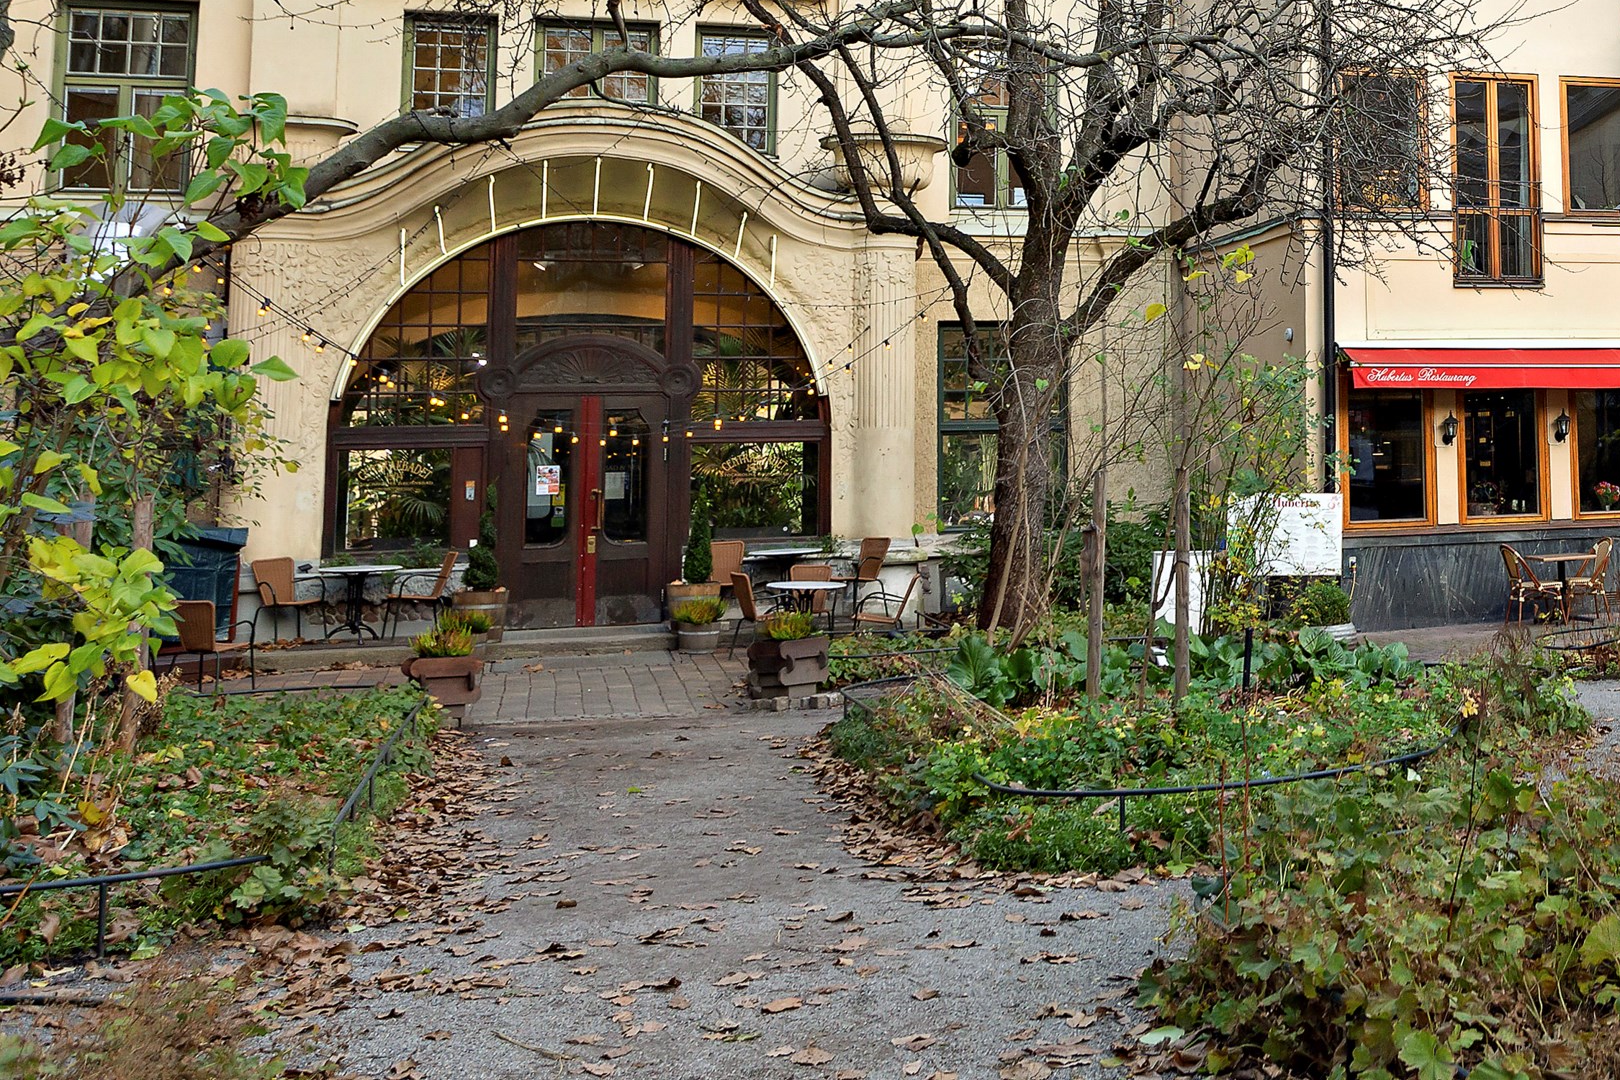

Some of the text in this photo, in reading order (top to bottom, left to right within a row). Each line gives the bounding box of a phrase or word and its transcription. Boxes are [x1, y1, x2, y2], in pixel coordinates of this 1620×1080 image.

[1367, 368, 1477, 386] Hubertus Restaurang
[357, 460, 433, 480] CRALBADET
[721, 451, 789, 471] CENTRADET
[1272, 496, 1321, 508] Hubert
